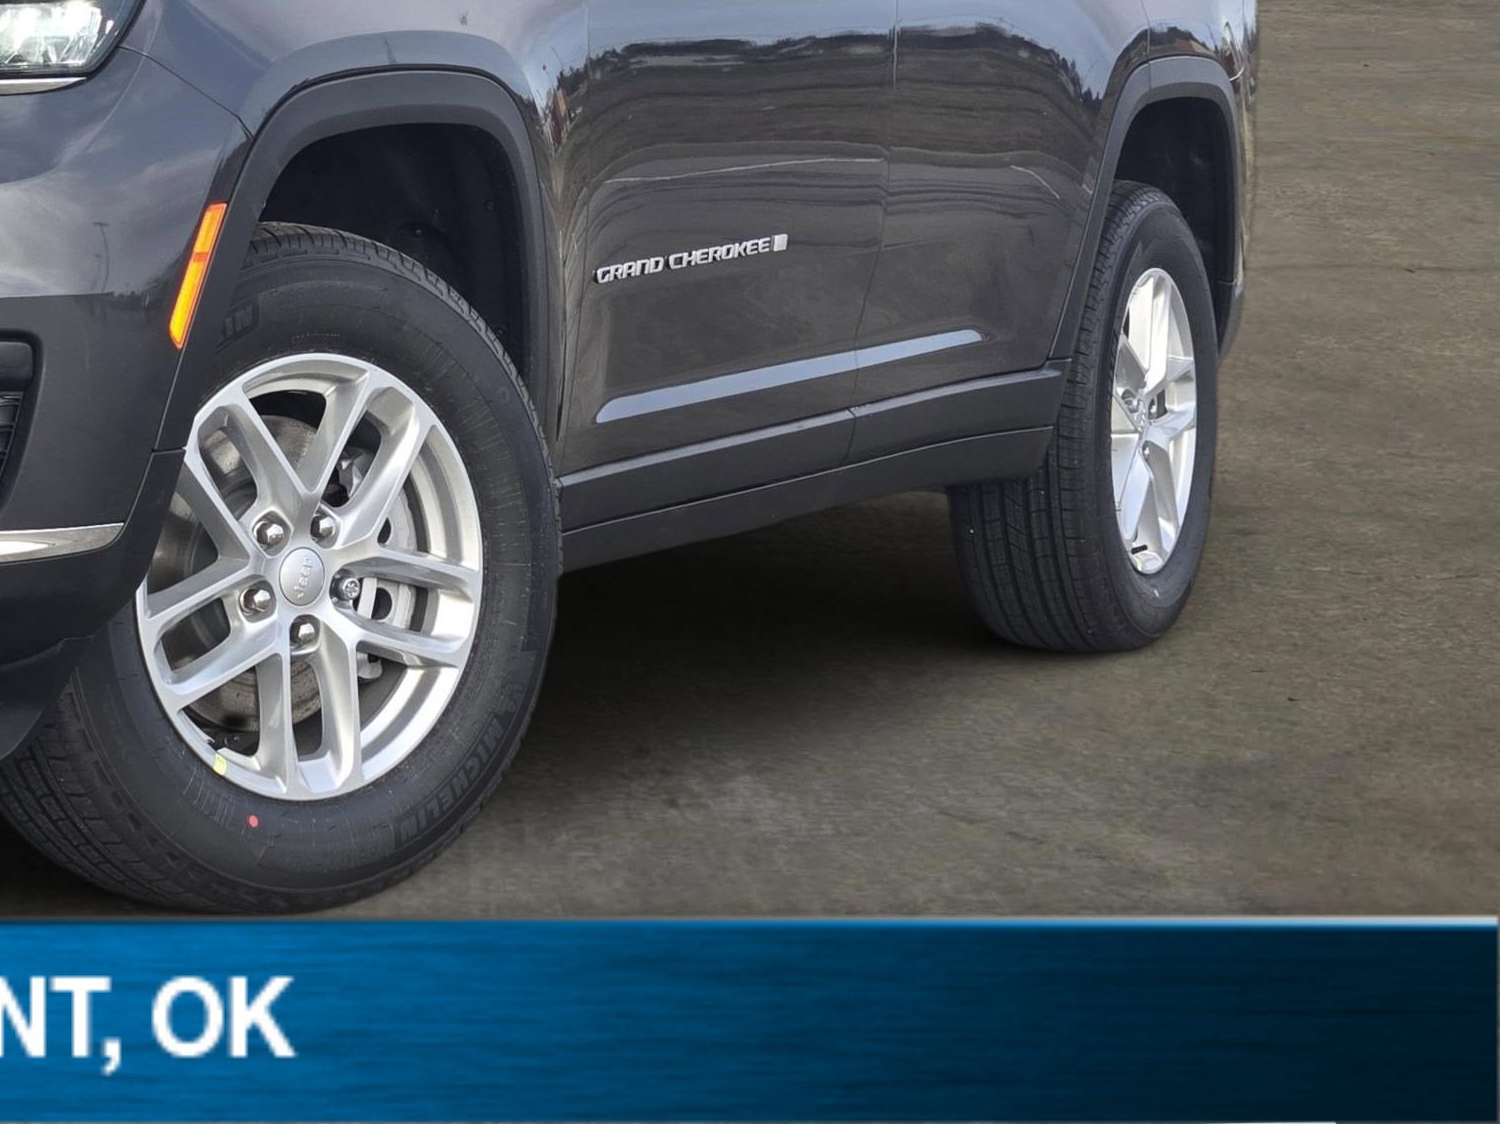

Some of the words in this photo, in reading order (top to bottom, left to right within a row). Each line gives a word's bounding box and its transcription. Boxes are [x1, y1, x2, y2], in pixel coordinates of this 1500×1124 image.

[595, 255, 664, 284] GRAND
[668, 237, 771, 270] CHEROKEE
[293, 556, 313, 599] Jeep
[400, 717, 505, 840] MICHELIN
